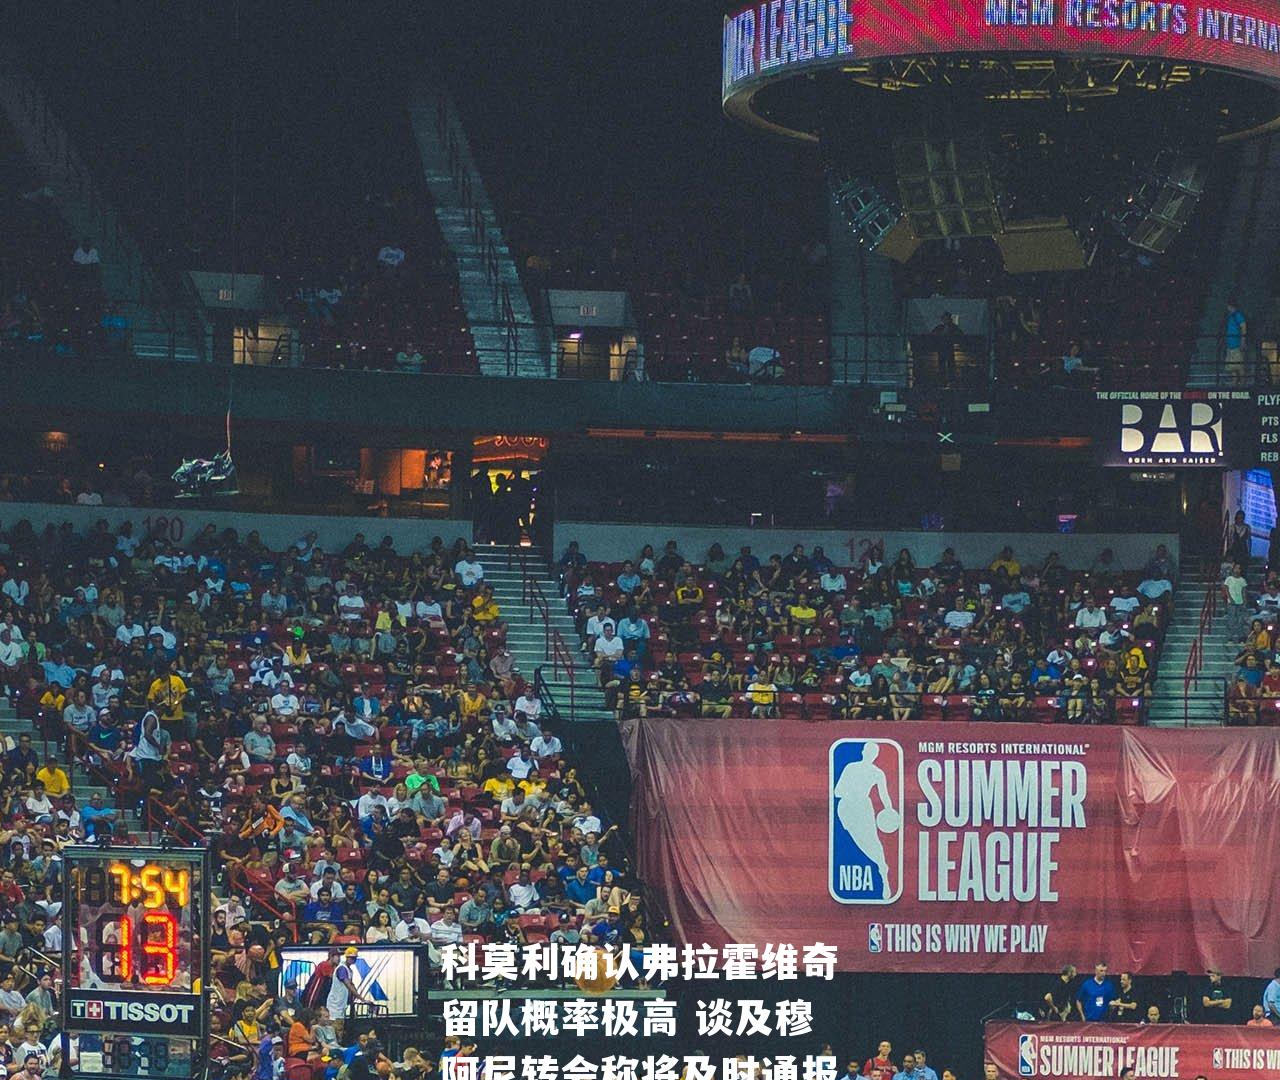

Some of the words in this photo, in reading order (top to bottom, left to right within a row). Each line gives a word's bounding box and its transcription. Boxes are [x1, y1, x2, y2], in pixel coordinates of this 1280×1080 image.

[1261, 416, 1280, 427] PTS
[1261, 433, 1279, 444] FLS
[1260, 452, 1279, 463] REB
[918, 742, 945, 753] MGM
[948, 743, 997, 754] RESORTS
[1001, 743, 1086, 756] INTERNATIONAL
[917, 759, 1088, 828] SUMMER
[839, 864, 874, 892] NBA
[918, 831, 1059, 902] LEAGUE
[109, 863, 190, 910] 7:54
[121, 912, 177, 986] 13
[885, 924, 922, 953] THIS
[925, 924, 942, 953] IS
[944, 924, 981, 953] WHY
[983, 924, 1008, 953] WE
[1010, 924, 1049, 953] PLAY
[105, 1001, 194, 1024] TISSOT
[1039, 1044, 1114, 1077] SUMMER
[1117, 1046, 1179, 1078] LEAGUE
[1225, 1048, 1251, 1070] THIS
[1252, 1049, 1265, 1070] IS
